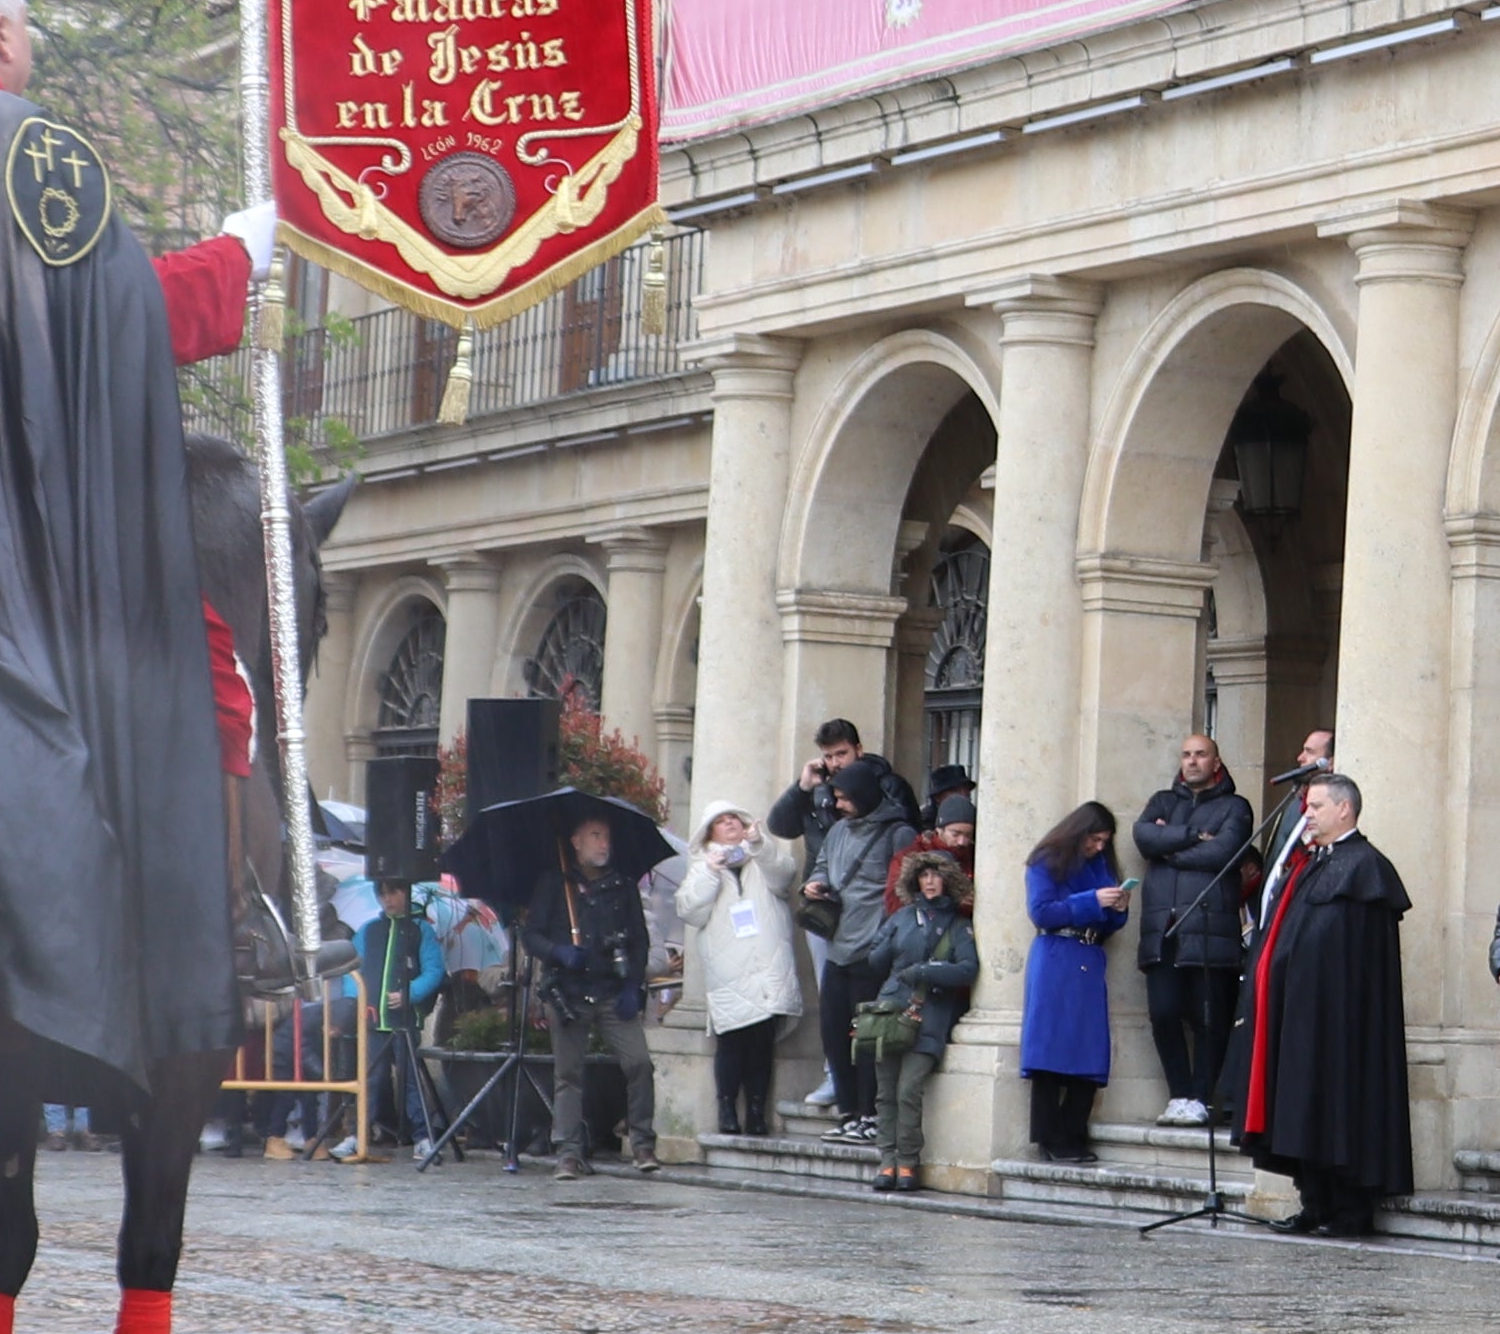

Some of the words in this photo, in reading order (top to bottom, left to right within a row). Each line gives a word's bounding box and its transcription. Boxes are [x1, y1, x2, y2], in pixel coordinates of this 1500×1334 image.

[349, 32, 403, 76] de
[336, 100, 392, 129] en
[401, 80, 449, 129] la
[462, 78, 585, 126] Cruz
[466, 132, 503, 155] 1962
